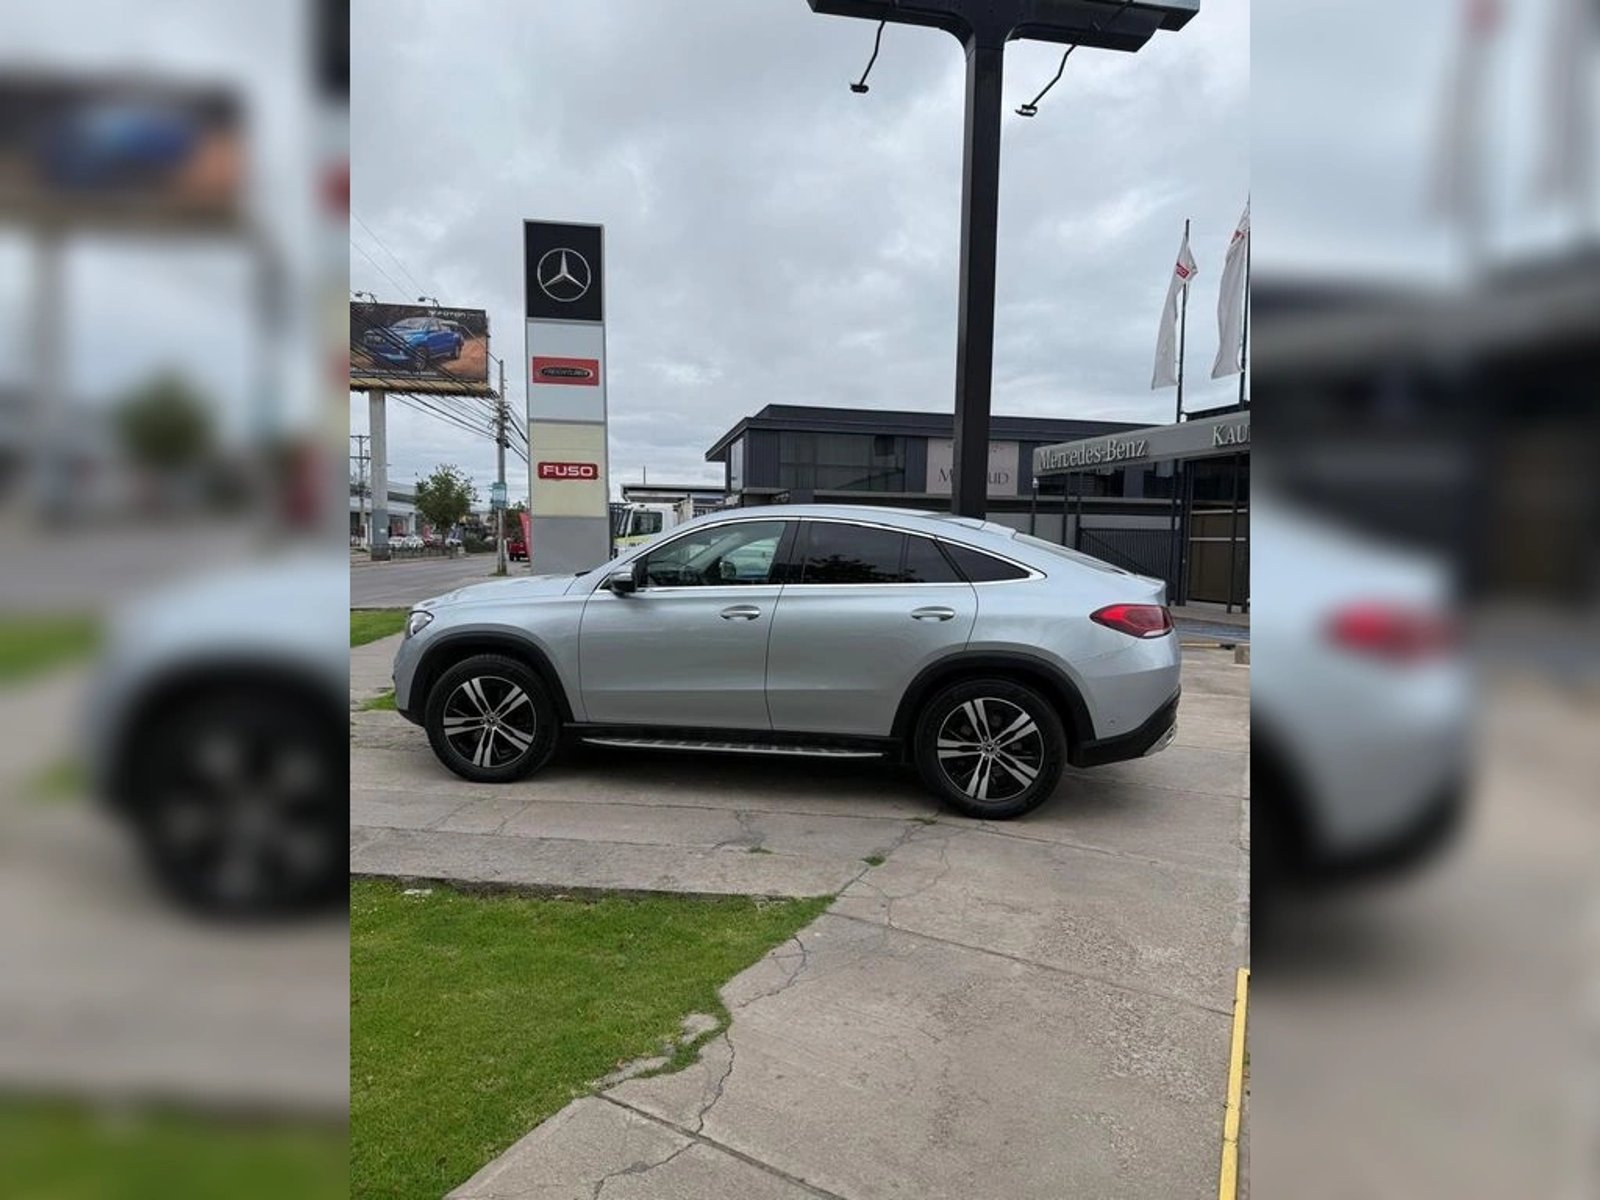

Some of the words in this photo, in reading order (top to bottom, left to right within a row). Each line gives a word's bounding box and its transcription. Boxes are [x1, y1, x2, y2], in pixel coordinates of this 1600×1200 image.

[1212, 424, 1250, 446] KAU
[1038, 438, 1147, 471] Mercedes-Benz
[543, 465, 593, 477] FUSO
